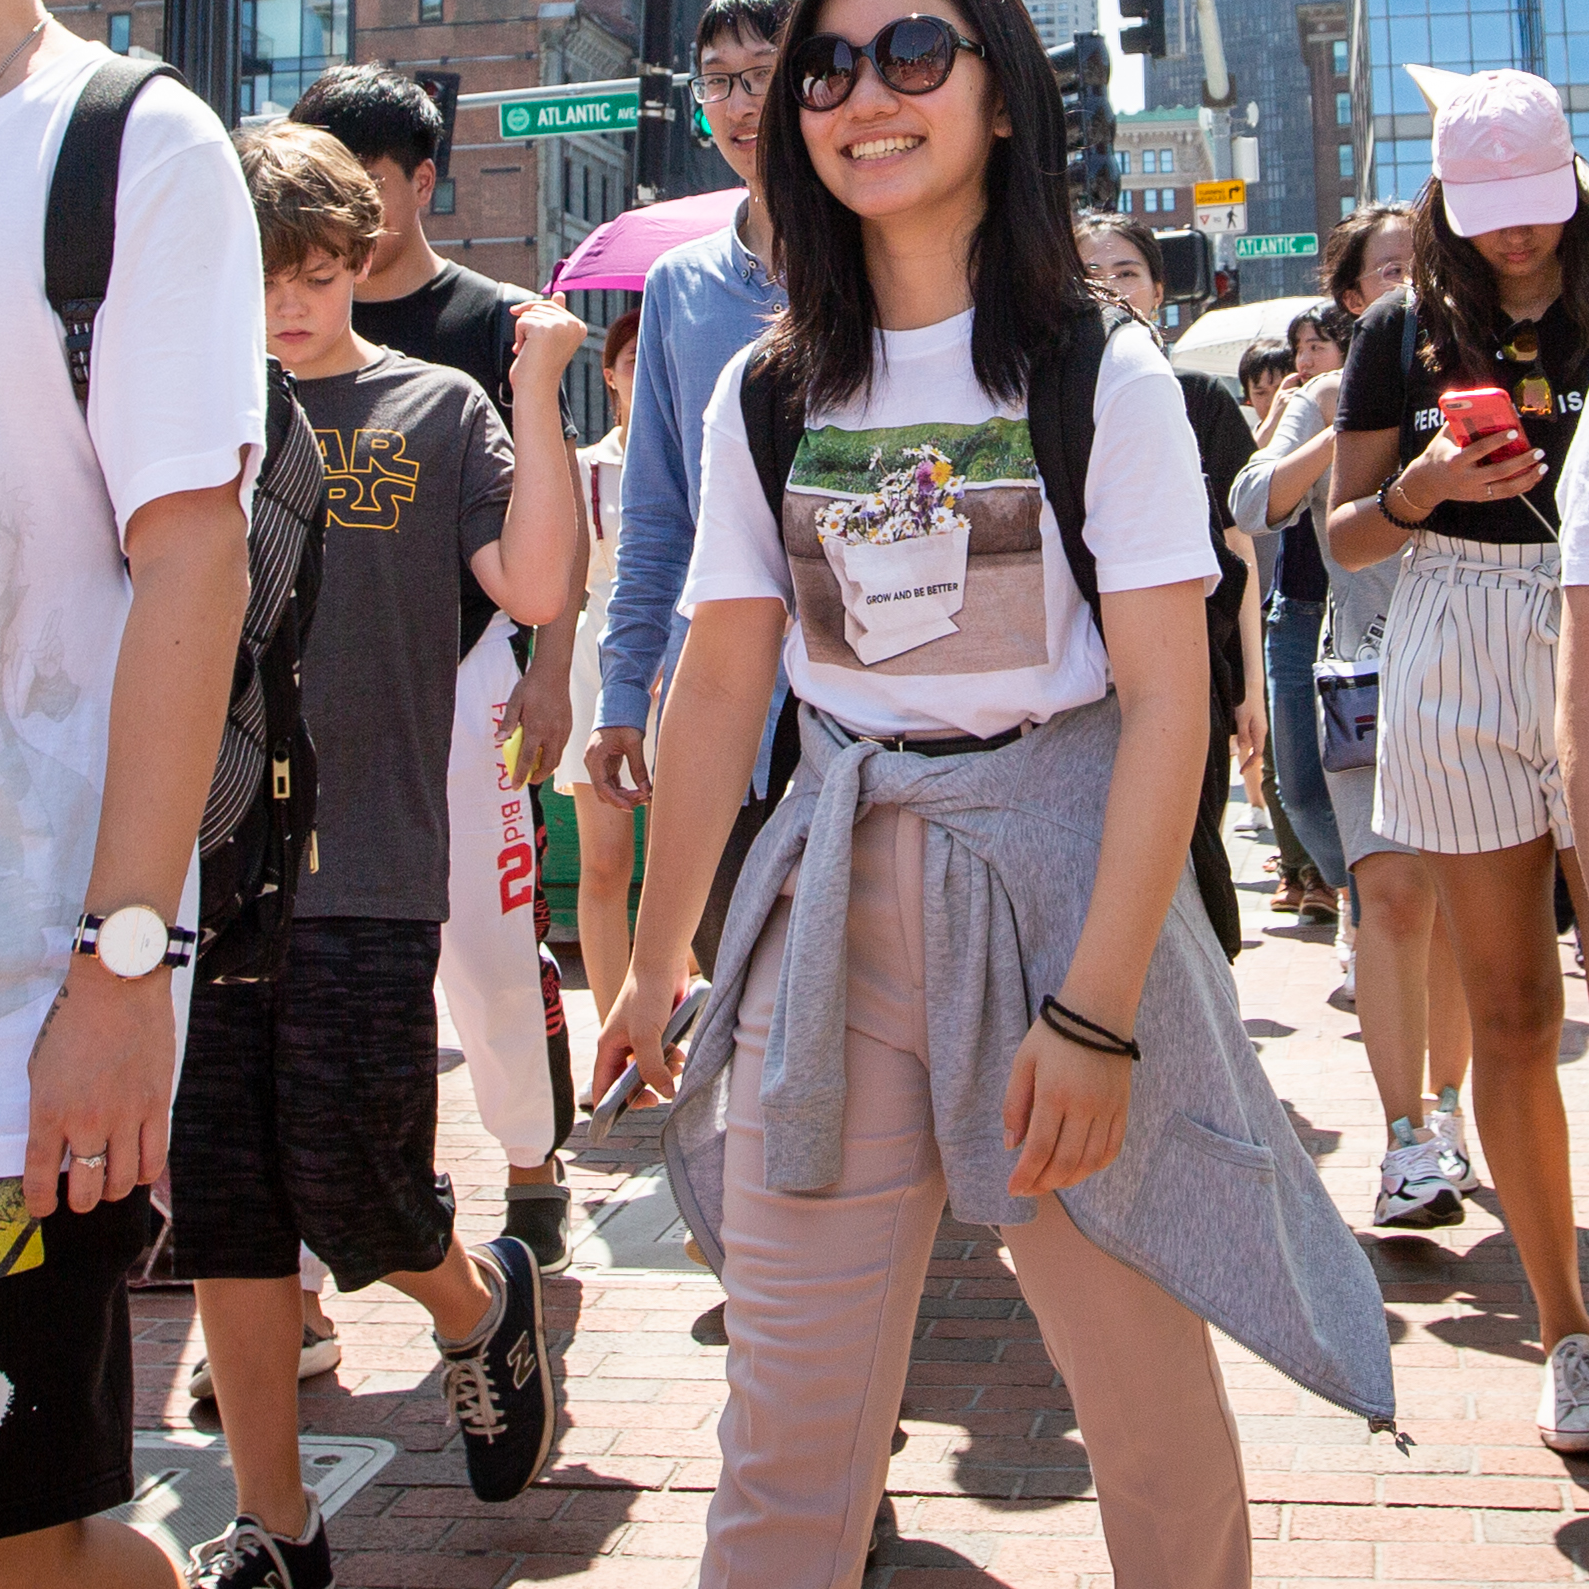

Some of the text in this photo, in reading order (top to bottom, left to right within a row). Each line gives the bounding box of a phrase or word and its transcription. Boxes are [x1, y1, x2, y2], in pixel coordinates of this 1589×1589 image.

[536, 102, 611, 127] ATLANTIC
[617, 106, 636, 120] AVE
[1238, 237, 1316, 257] ATLANTIC AVE
[1556, 390, 1584, 414] IS
[866, 582, 959, 605] GROW AND BE BETTER
[500, 800, 526, 844] Bid
